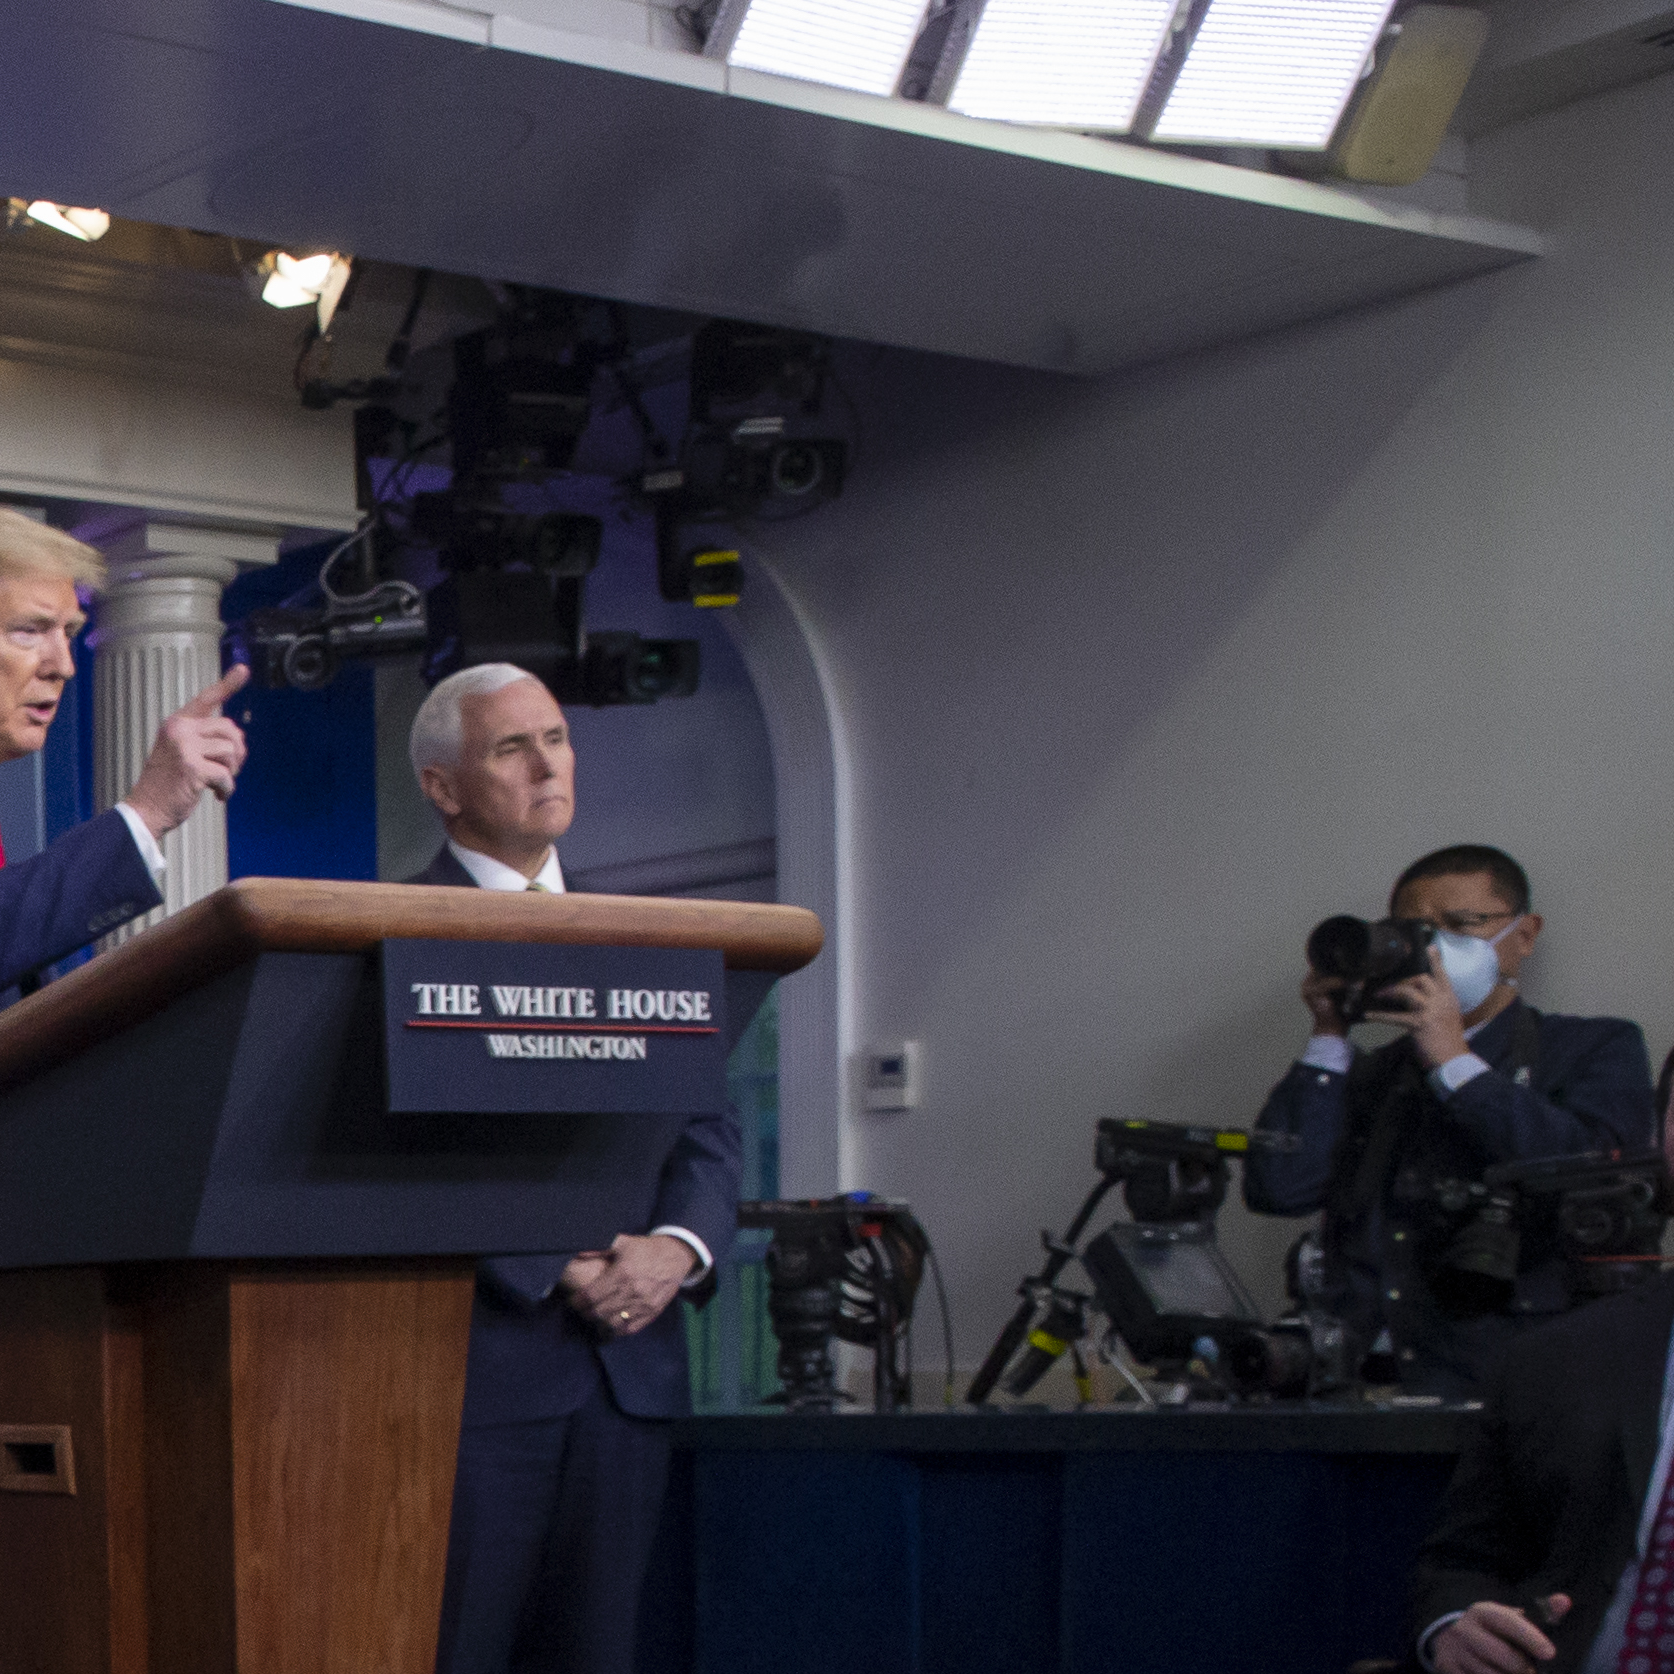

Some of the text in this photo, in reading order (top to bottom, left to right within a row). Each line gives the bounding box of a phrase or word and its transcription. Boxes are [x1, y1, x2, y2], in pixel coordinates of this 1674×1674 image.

[412, 984, 712, 1021] THE WHITE HOUSE
[486, 1034, 646, 1060] WASHINGTON
